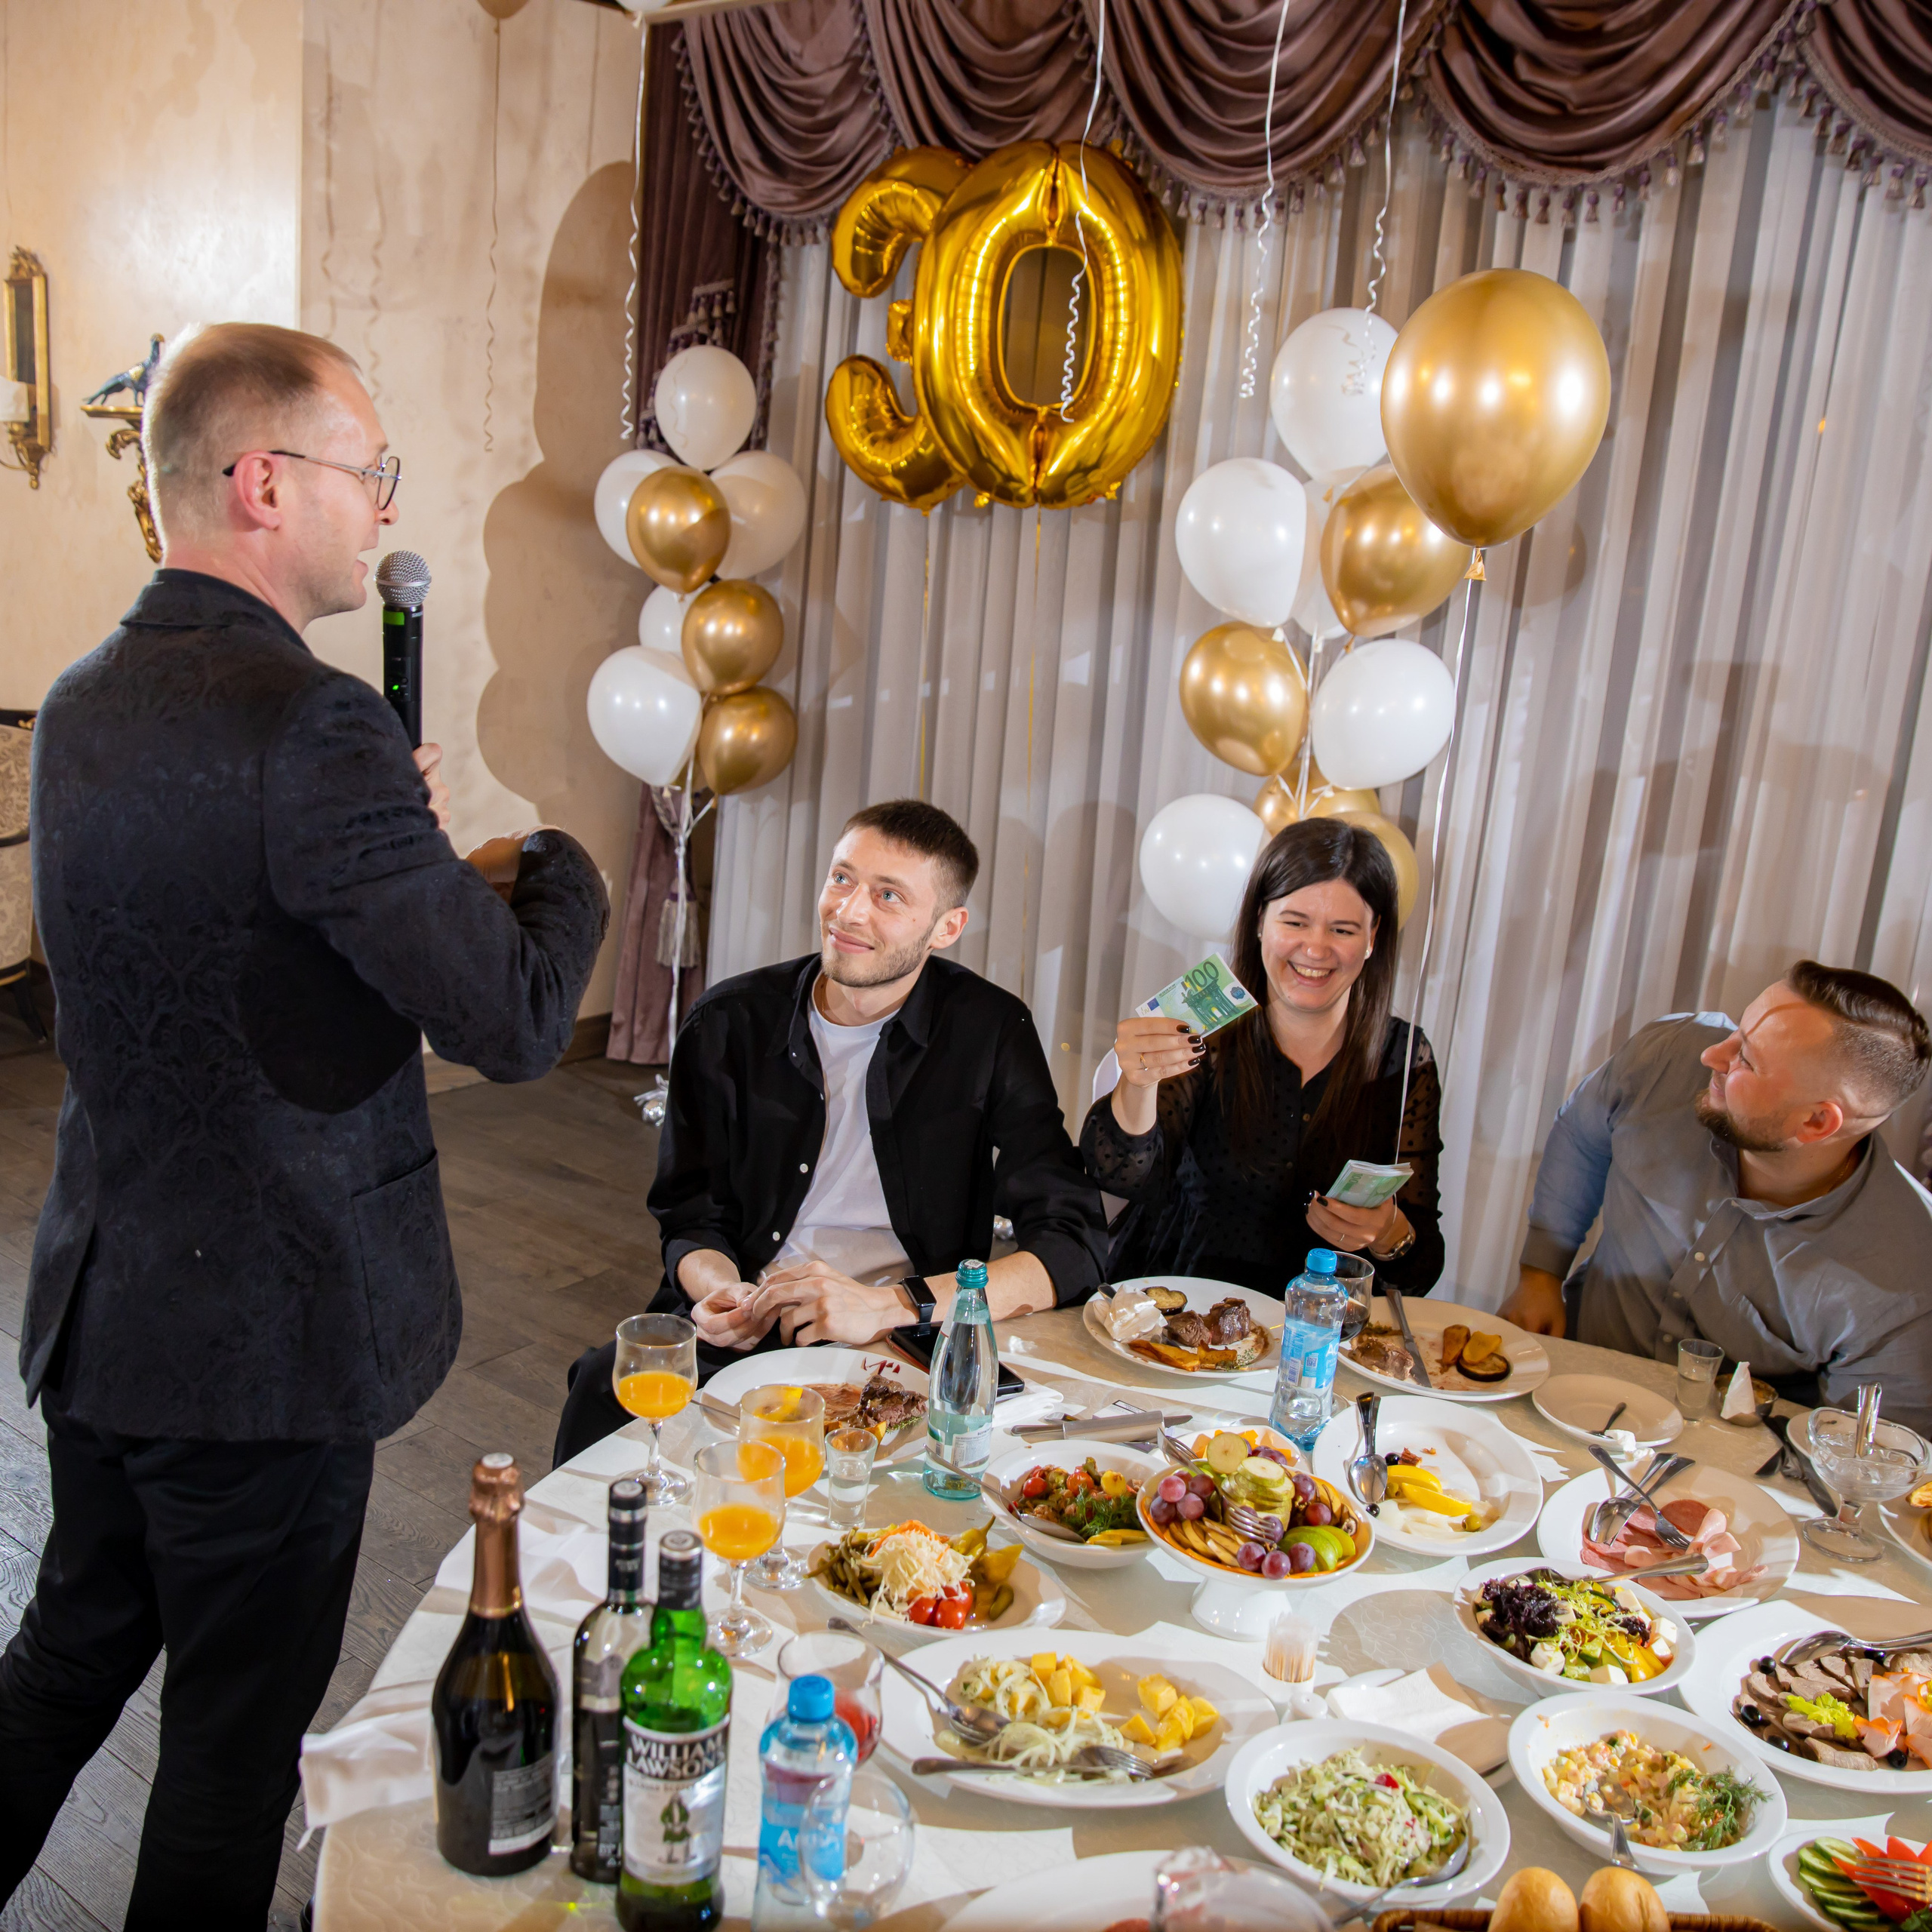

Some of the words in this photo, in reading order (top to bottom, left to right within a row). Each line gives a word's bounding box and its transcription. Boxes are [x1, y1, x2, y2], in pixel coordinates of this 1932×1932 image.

[826, 139, 1184, 510] 30
[1184, 961, 1219, 992] 100
[631, 1732, 722, 1762] WILLIAM
